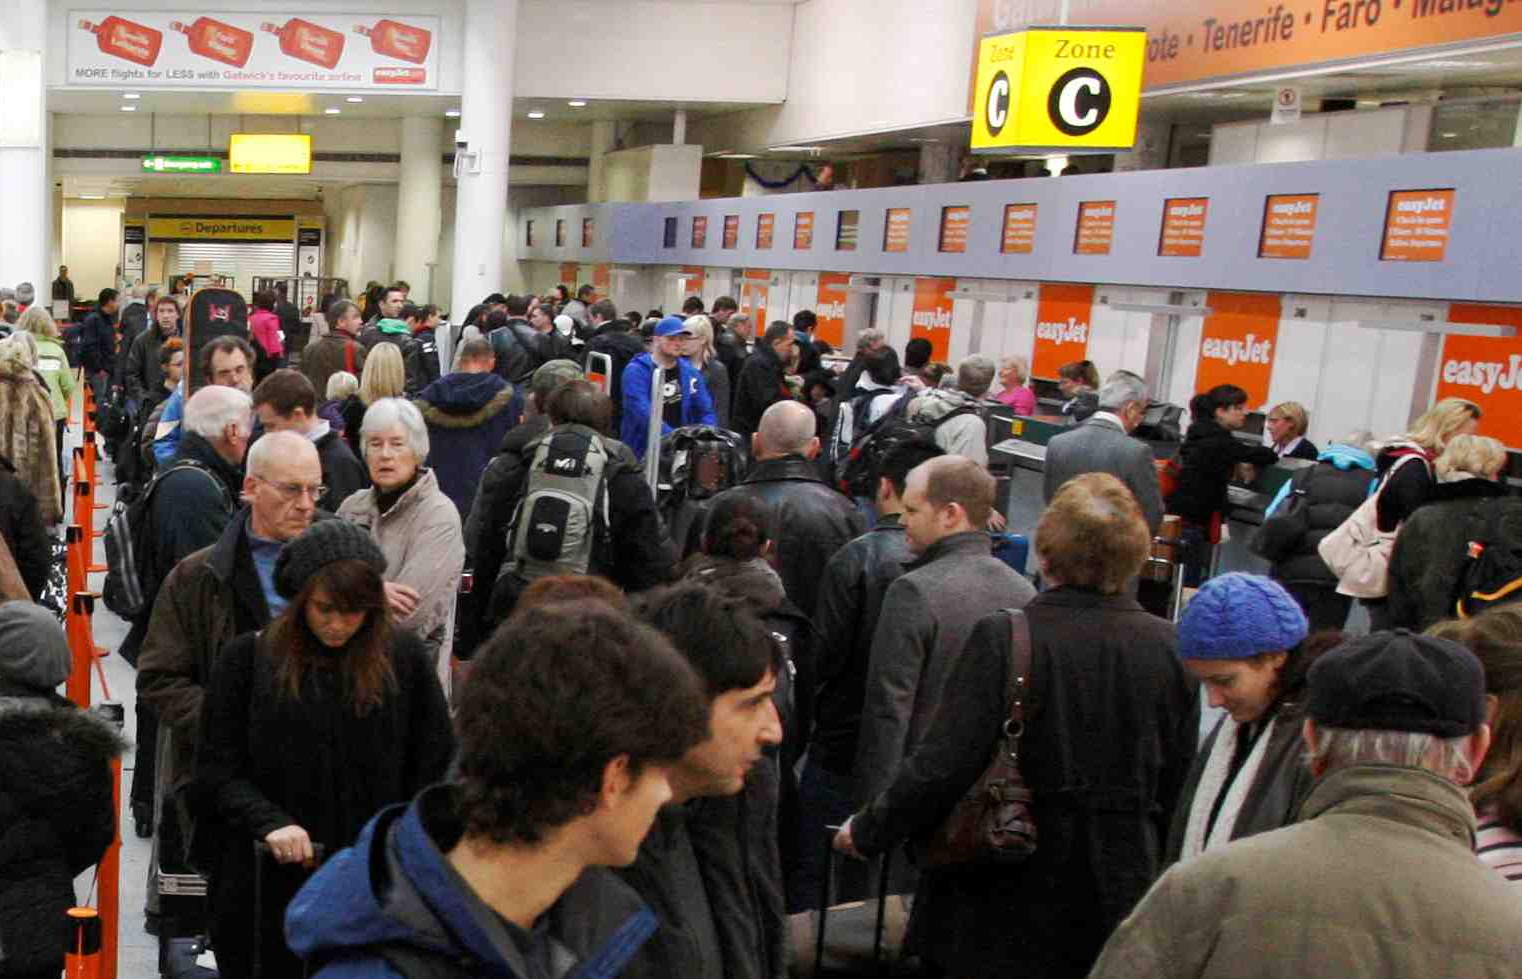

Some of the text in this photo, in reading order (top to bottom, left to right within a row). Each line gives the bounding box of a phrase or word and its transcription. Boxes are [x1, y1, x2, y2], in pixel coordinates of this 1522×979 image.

[1147, 30, 1179, 63] ote
[1201, 5, 1295, 53] Tenerife
[1320, 0, 1382, 34] Faro
[990, 44, 1015, 63] Zone
[1054, 38, 1116, 60] Zone
[75, 68, 110, 79] MORE
[111, 69, 144, 81] flights
[147, 69, 162, 79] for
[166, 69, 194, 80] LESS
[196, 69, 220, 80] with
[988, 79, 1009, 129] C
[1059, 75, 1102, 128] C
[195, 222, 263, 236] Departures
[913, 307, 952, 330] easyJet
[1037, 316, 1088, 345] easyJet
[1202, 333, 1272, 366] easyJet
